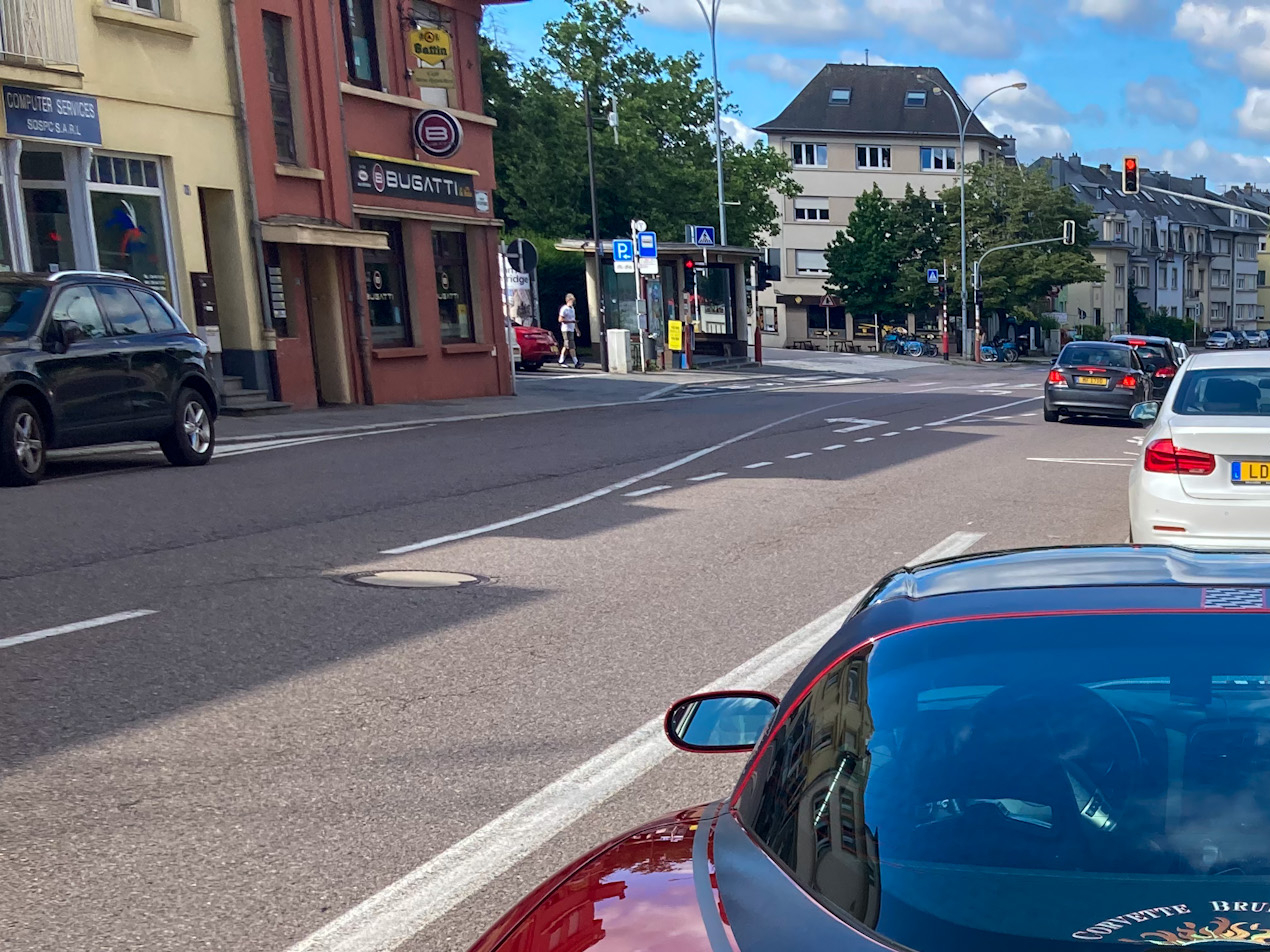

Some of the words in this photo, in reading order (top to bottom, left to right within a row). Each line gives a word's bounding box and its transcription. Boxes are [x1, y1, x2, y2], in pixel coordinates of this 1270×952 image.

[6, 92, 52, 113] COMPUTER
[56, 99, 96, 118] SERVICES
[386, 170, 458, 196] BUGATTI
[618, 243, 627, 258] P
[1249, 464, 1269, 479] LD
[1072, 904, 1191, 941] CORVETTE
